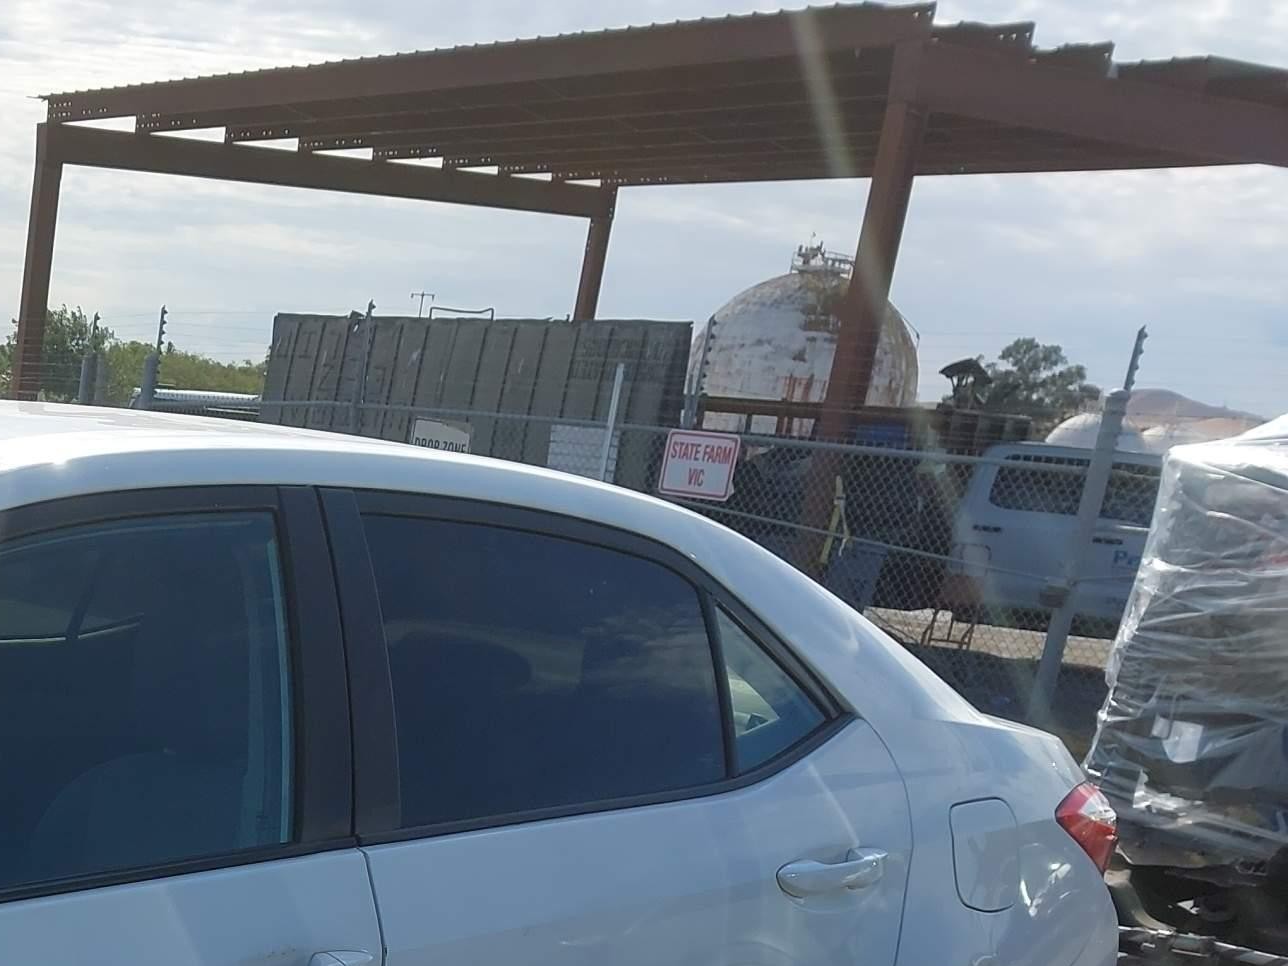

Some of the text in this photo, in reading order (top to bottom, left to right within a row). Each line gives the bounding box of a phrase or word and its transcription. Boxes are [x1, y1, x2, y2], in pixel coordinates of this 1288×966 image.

[671, 441, 732, 465] STATE FARM
[688, 466, 705, 487] VIC
